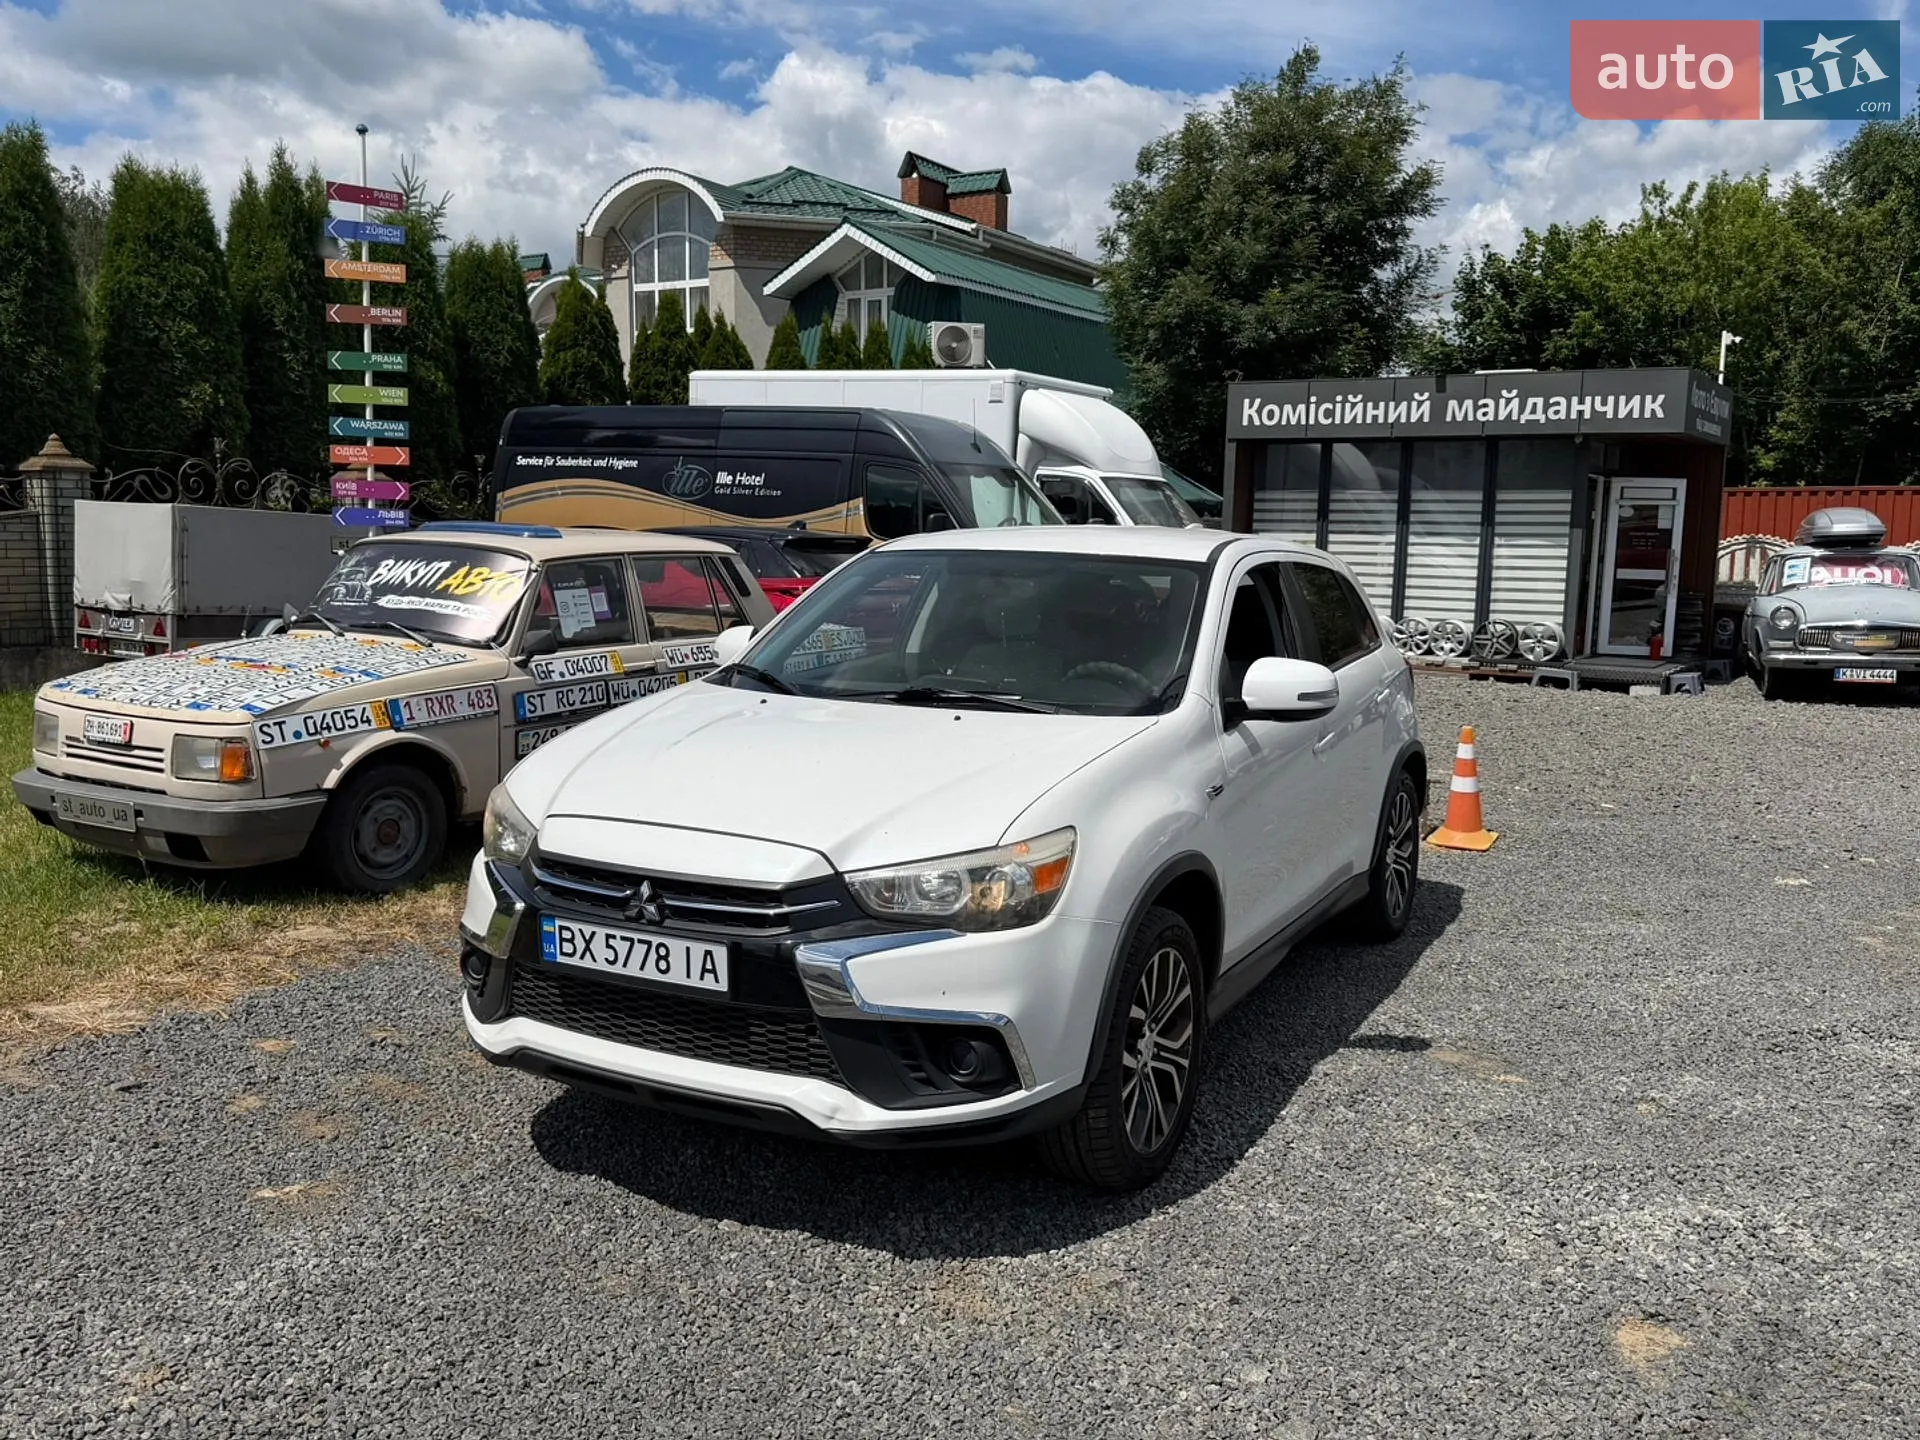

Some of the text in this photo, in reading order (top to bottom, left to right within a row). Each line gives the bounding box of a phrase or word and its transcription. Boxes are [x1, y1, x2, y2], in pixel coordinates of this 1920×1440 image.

[373, 190, 399, 202] PARIS
[365, 224, 401, 238] ZÜRICH
[341, 262, 401, 275] AMSTERDAM
[370, 307, 402, 317] BERLIN
[371, 354, 403, 364] PRAHA
[378, 388, 404, 398] WIEN
[1241, 388, 1666, 426] Комісійний майданчик
[349, 419, 405, 431] WARSZAWA
[335, 446, 368, 457] ОДЕСА
[516, 455, 638, 470] Service für Sauberkeit und Hygiene
[735, 472, 765, 486] Hotel
[336, 481, 357, 491] КИЇВ
[377, 510, 404, 520] ЛЬВІВ
[367, 558, 451, 588] ВИКУП
[534, 661, 555, 680] GF
[564, 654, 608, 676] 04007
[1869, 670, 1895, 679] 4444
[611, 681, 631, 700] WÜ
[527, 684, 605, 714] ST RC 210
[259, 720, 287, 745] ST
[303, 706, 372, 737] 04054
[543, 942, 556, 954] UA
[558, 925, 720, 984] BX 5778 IA
